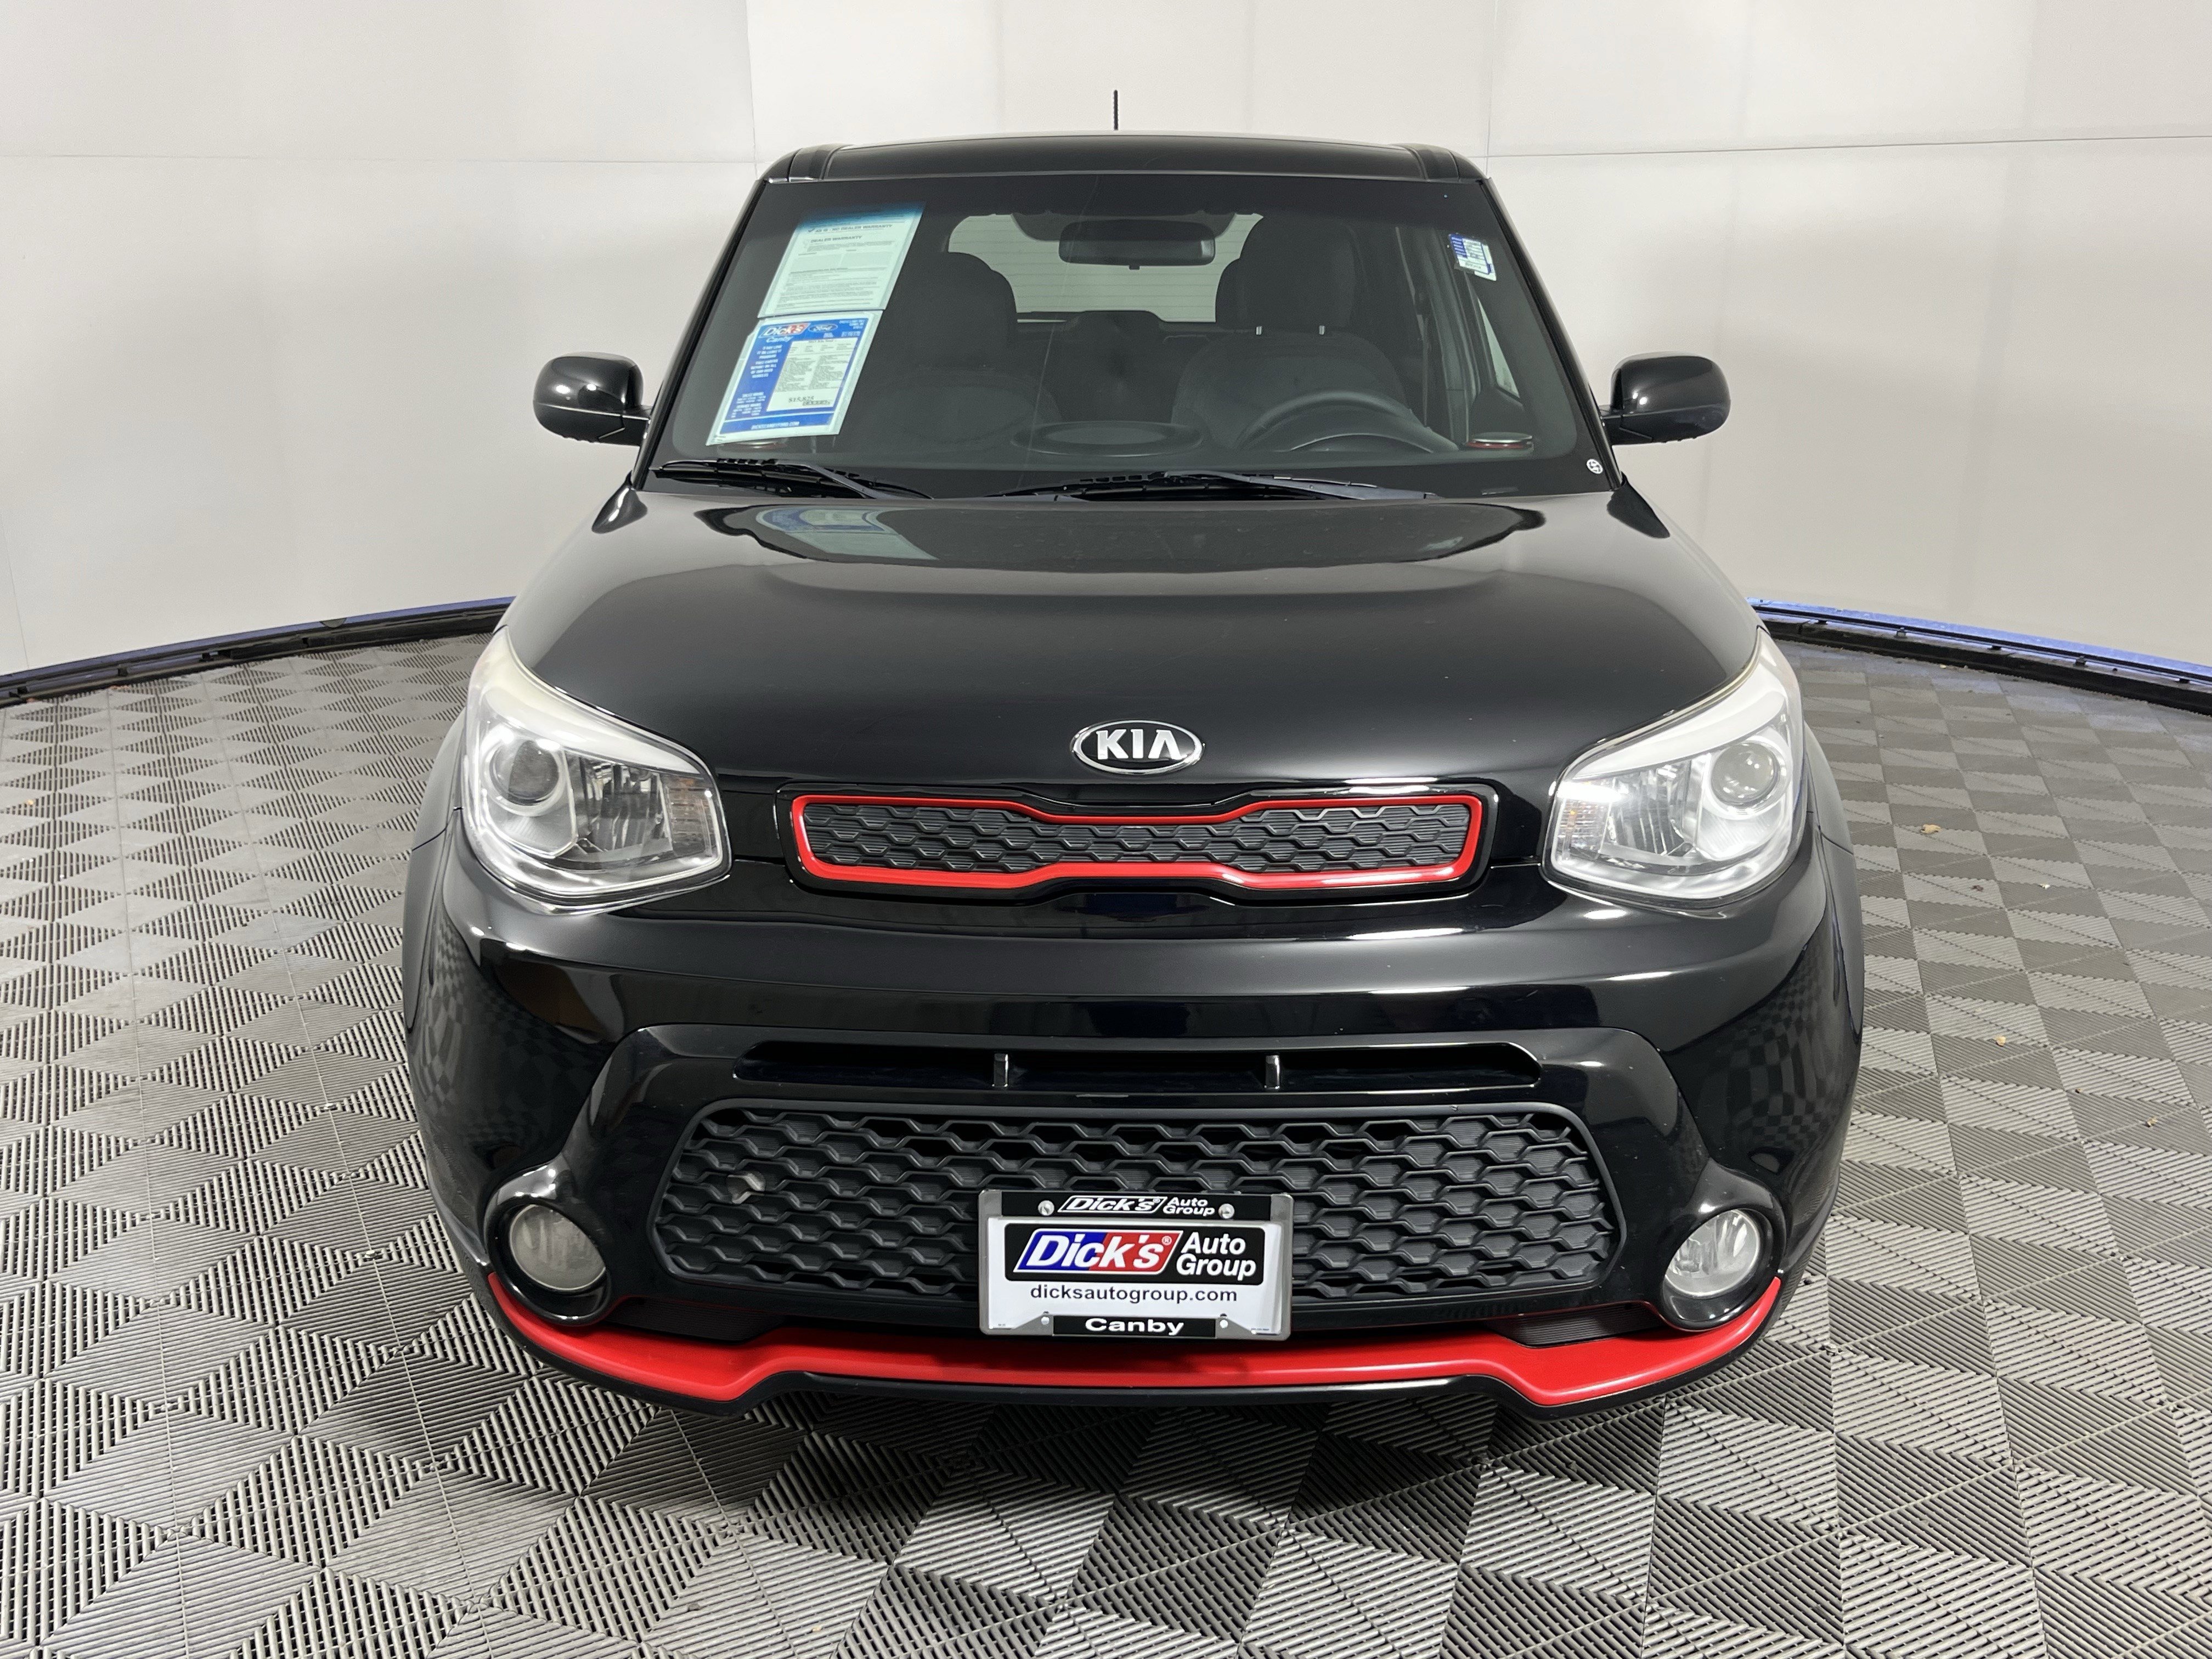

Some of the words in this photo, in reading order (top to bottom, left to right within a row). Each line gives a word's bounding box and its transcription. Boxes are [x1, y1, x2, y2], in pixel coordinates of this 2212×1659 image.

[1096, 729, 1185, 760] KIA
[1066, 1197, 1155, 1211] Dick's
[1163, 1205, 1215, 1217] Group
[1166, 1197, 1207, 1207] Auto
[1026, 1233, 1162, 1268] Dick's
[1181, 1232, 1245, 1255] Auto
[1176, 1254, 1256, 1281] Group
[1030, 1285, 1237, 1304] dicksautogroup.com
[1085, 1318, 1184, 1335] Canby
